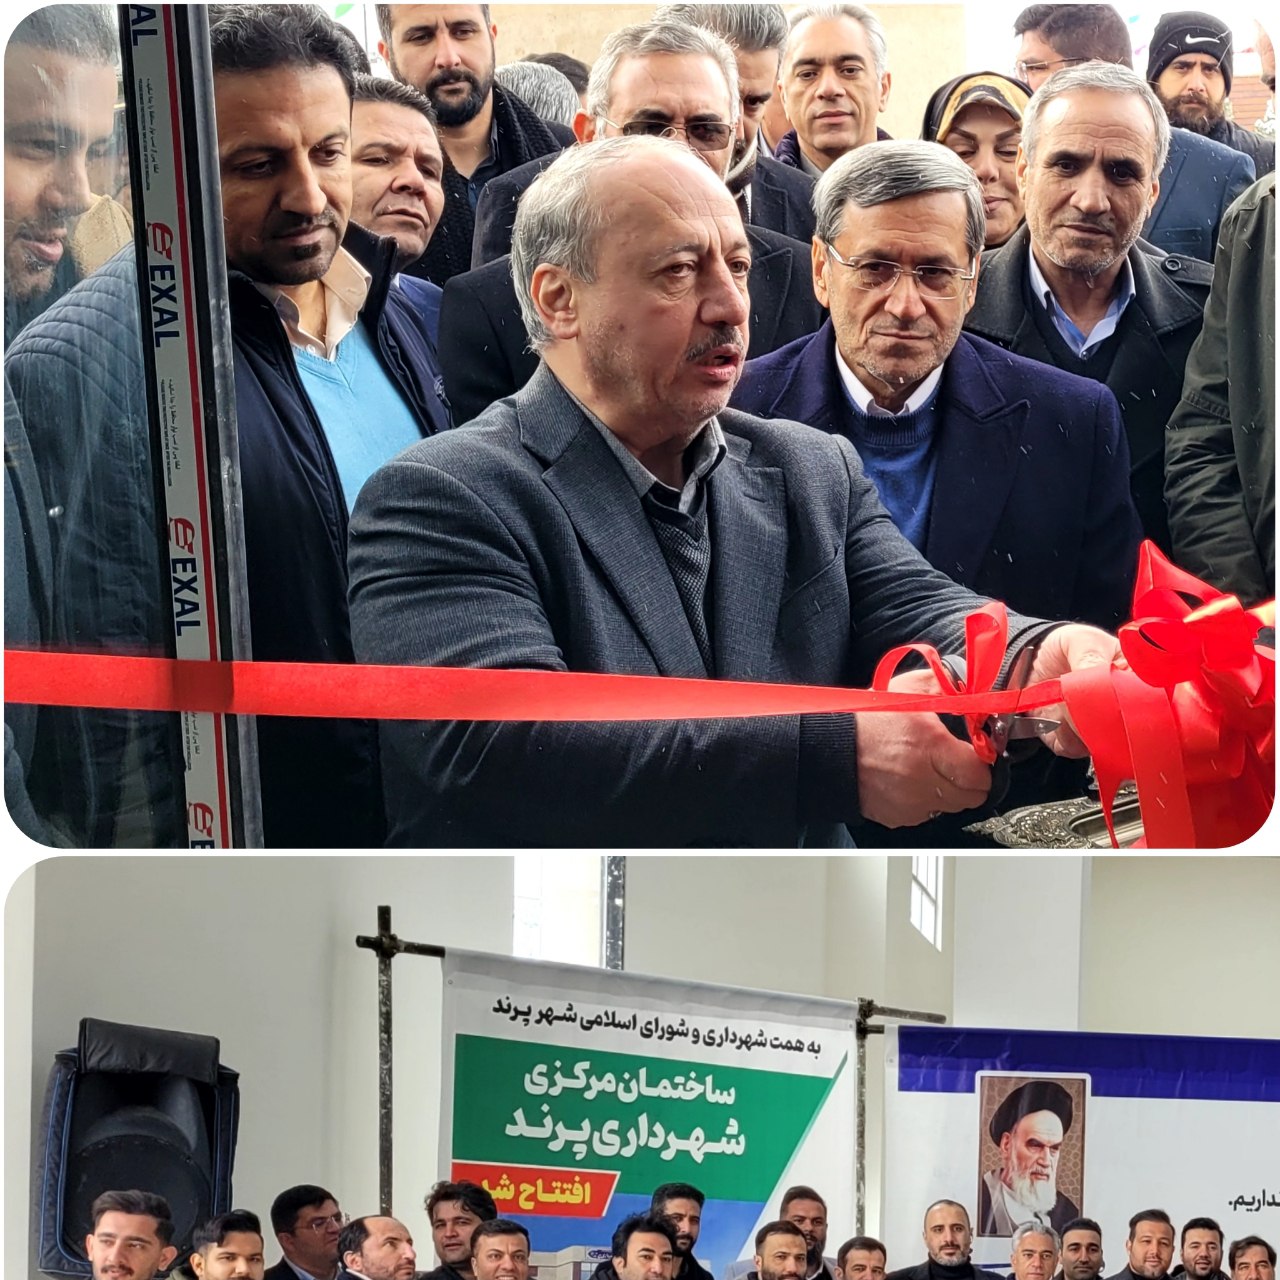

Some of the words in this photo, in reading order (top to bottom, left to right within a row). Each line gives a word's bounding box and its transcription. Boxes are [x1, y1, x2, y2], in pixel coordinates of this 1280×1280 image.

[130, 4, 157, 46] AL
[150, 265, 180, 348] EXAL
[171, 558, 201, 636] EXAL
[492, 996, 532, 1027] پرند
[534, 1002, 578, 1027] شهر
[579, 1009, 637, 1032] اسلامی
[640, 1016, 690, 1042] شورای
[691, 1027, 701, 1045] و
[702, 1025, 768, 1052] شهرداری
[769, 1034, 805, 1053] همت
[807, 1040, 822, 1060] به
[523, 1060, 617, 1100] مرکزی
[617, 1067, 736, 1105] ساختمان
[504, 1102, 592, 1161] پرند
[592, 1112, 746, 1164] شهرداری
[518, 1175, 592, 1210] افتتاح
